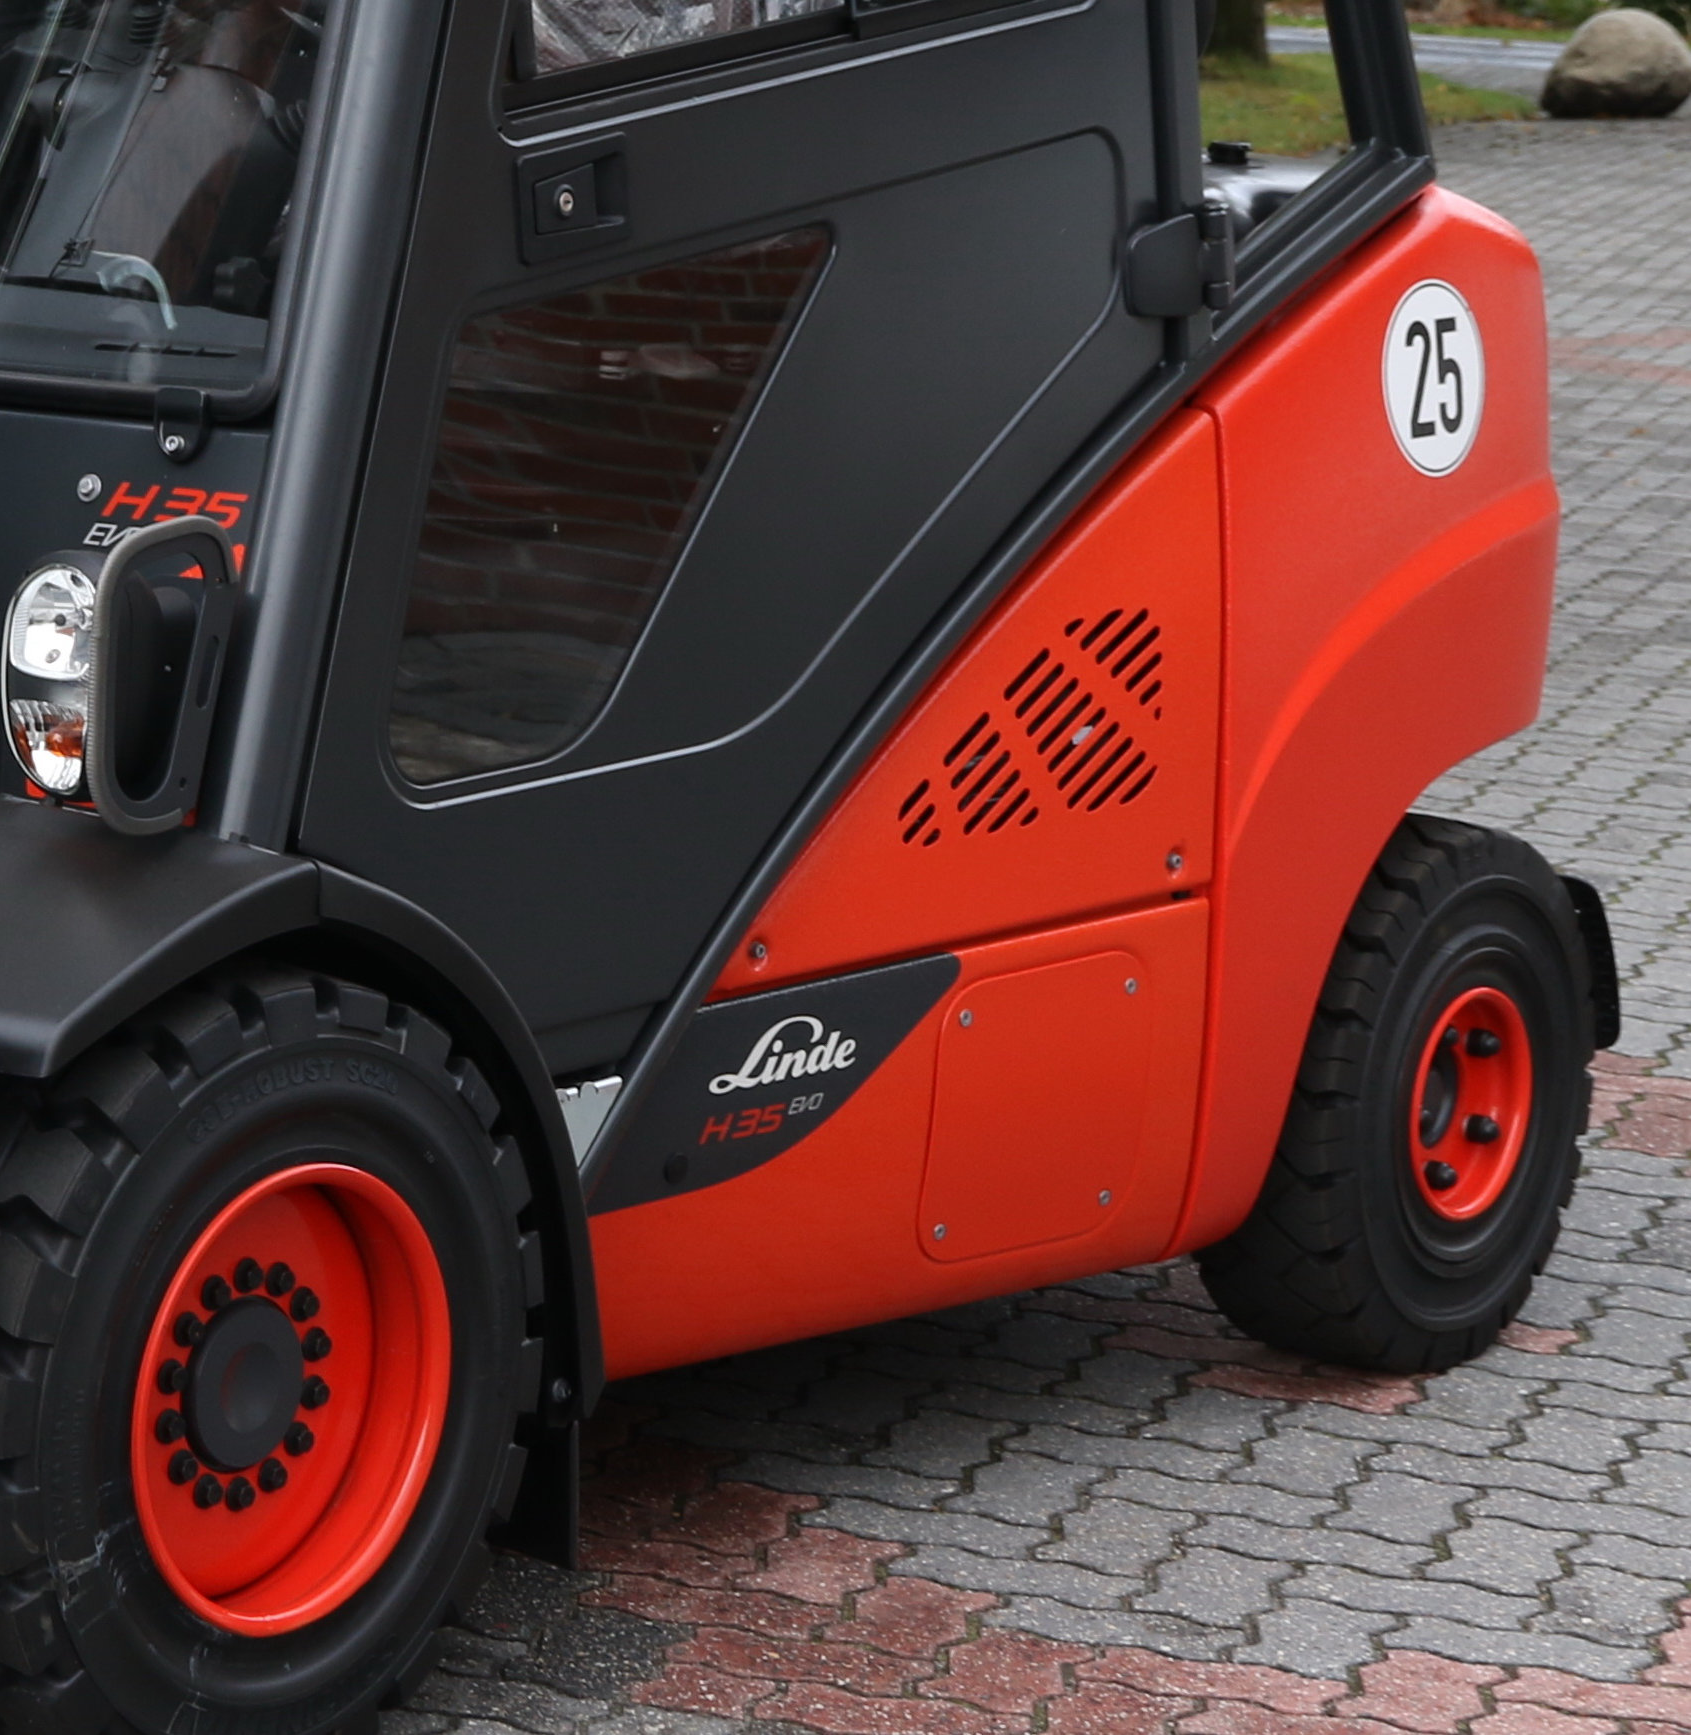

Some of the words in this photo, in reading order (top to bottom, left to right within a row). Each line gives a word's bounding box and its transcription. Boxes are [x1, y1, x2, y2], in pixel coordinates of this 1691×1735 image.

[1404, 317, 1464, 439] 25
[708, 1014, 857, 1095] Linde
[788, 1092, 824, 1116] EVO
